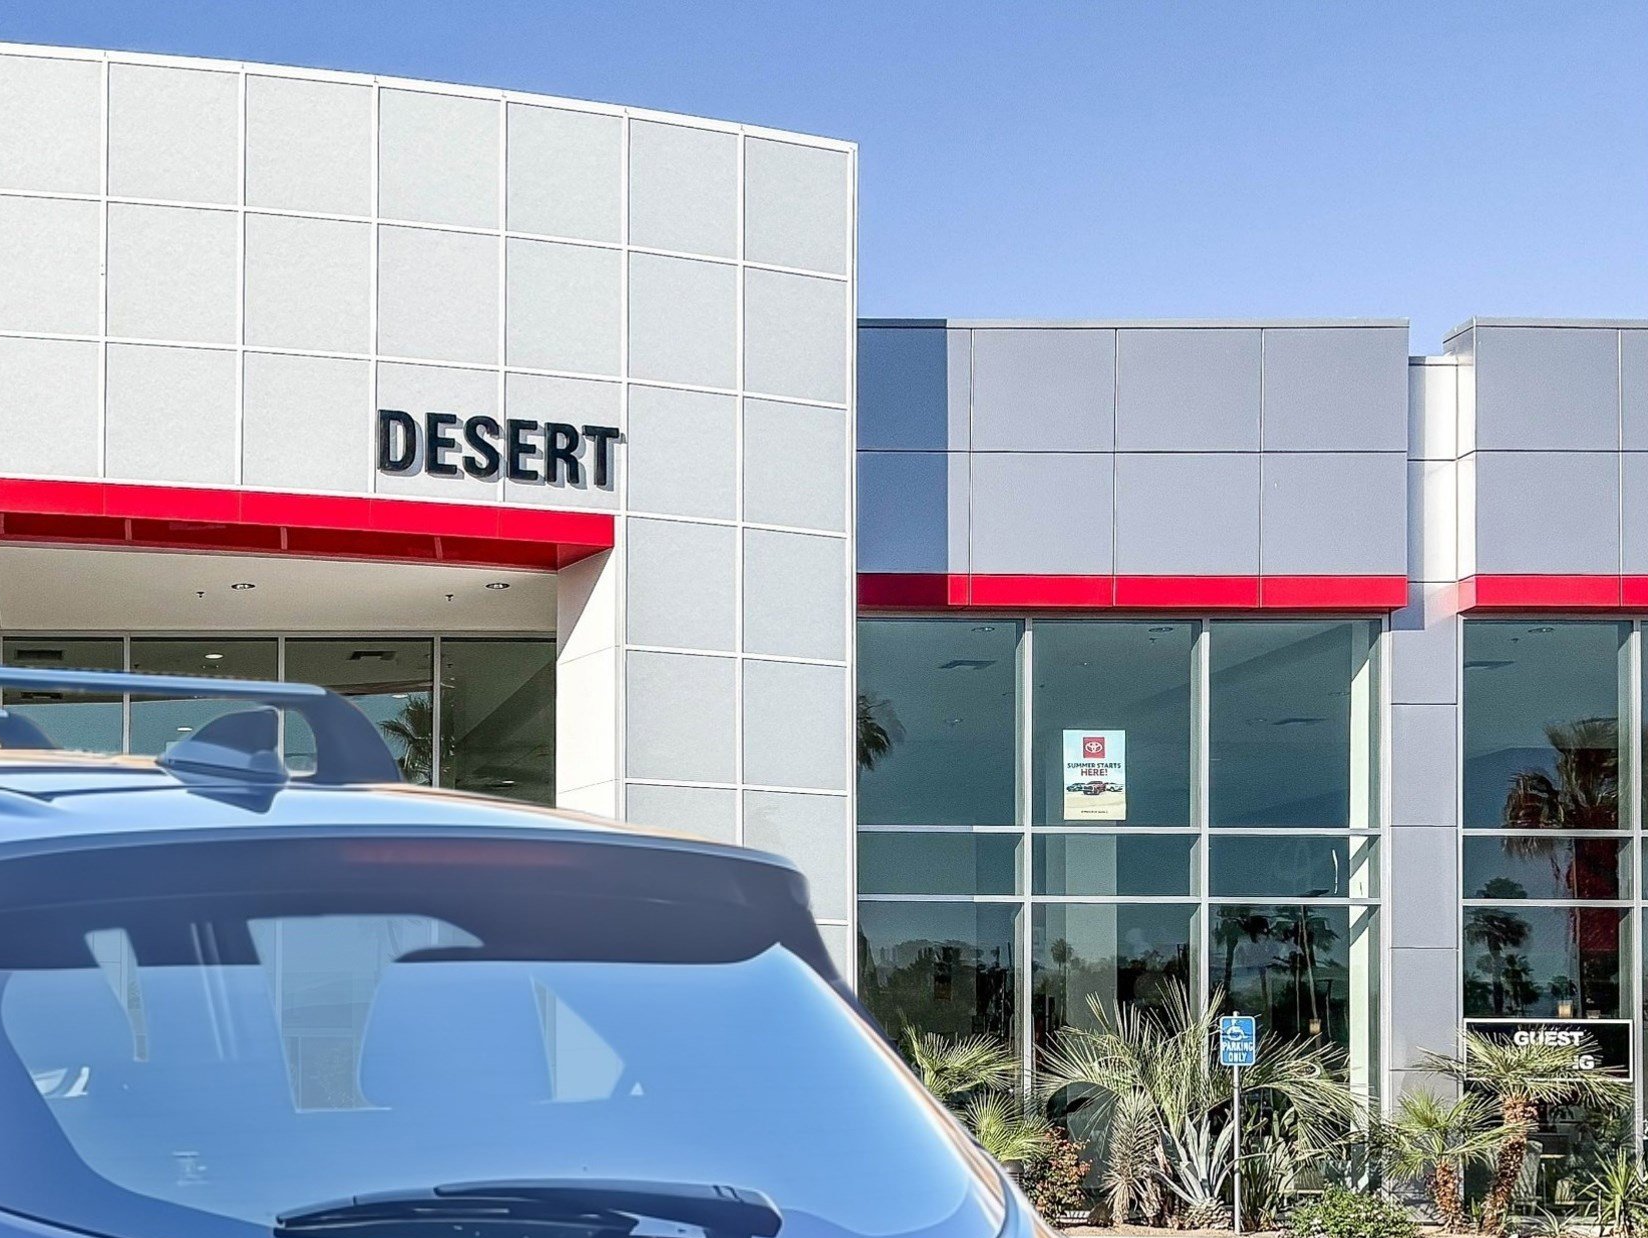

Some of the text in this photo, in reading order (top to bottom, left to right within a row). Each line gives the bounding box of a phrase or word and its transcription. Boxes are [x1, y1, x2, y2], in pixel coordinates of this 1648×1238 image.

[377, 408, 621, 487] DESERT
[1080, 768, 1108, 776] HERE!
[1513, 1031, 1584, 1047] GUEST
[1221, 1041, 1254, 1052] PARKING
[1228, 1051, 1248, 1063] ONLY
